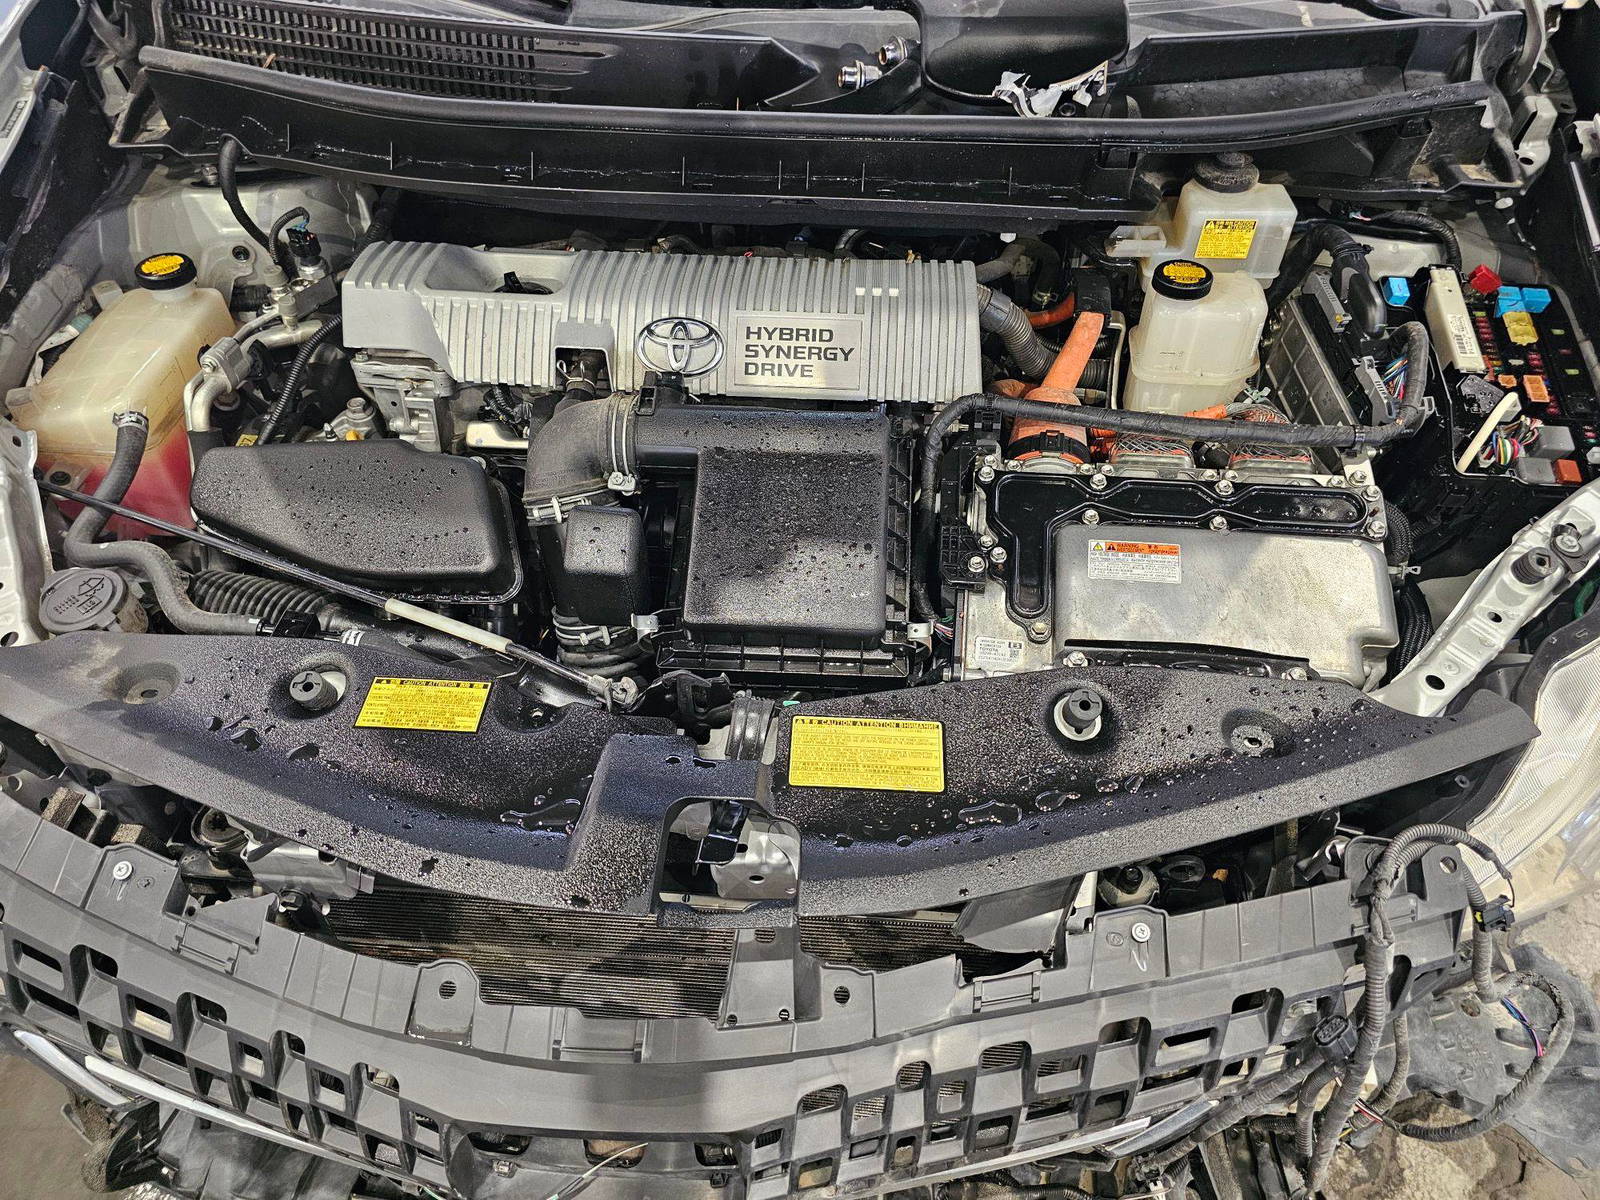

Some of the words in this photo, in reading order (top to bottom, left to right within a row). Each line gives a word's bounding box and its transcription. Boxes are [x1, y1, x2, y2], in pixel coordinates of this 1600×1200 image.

[745, 326, 834, 343] HYBRID
[744, 344, 855, 362] SYNERGY
[744, 361, 814, 378] DRIVE
[821, 719, 853, 727] CAUTION
[855, 720, 896, 729] ATTENTION
